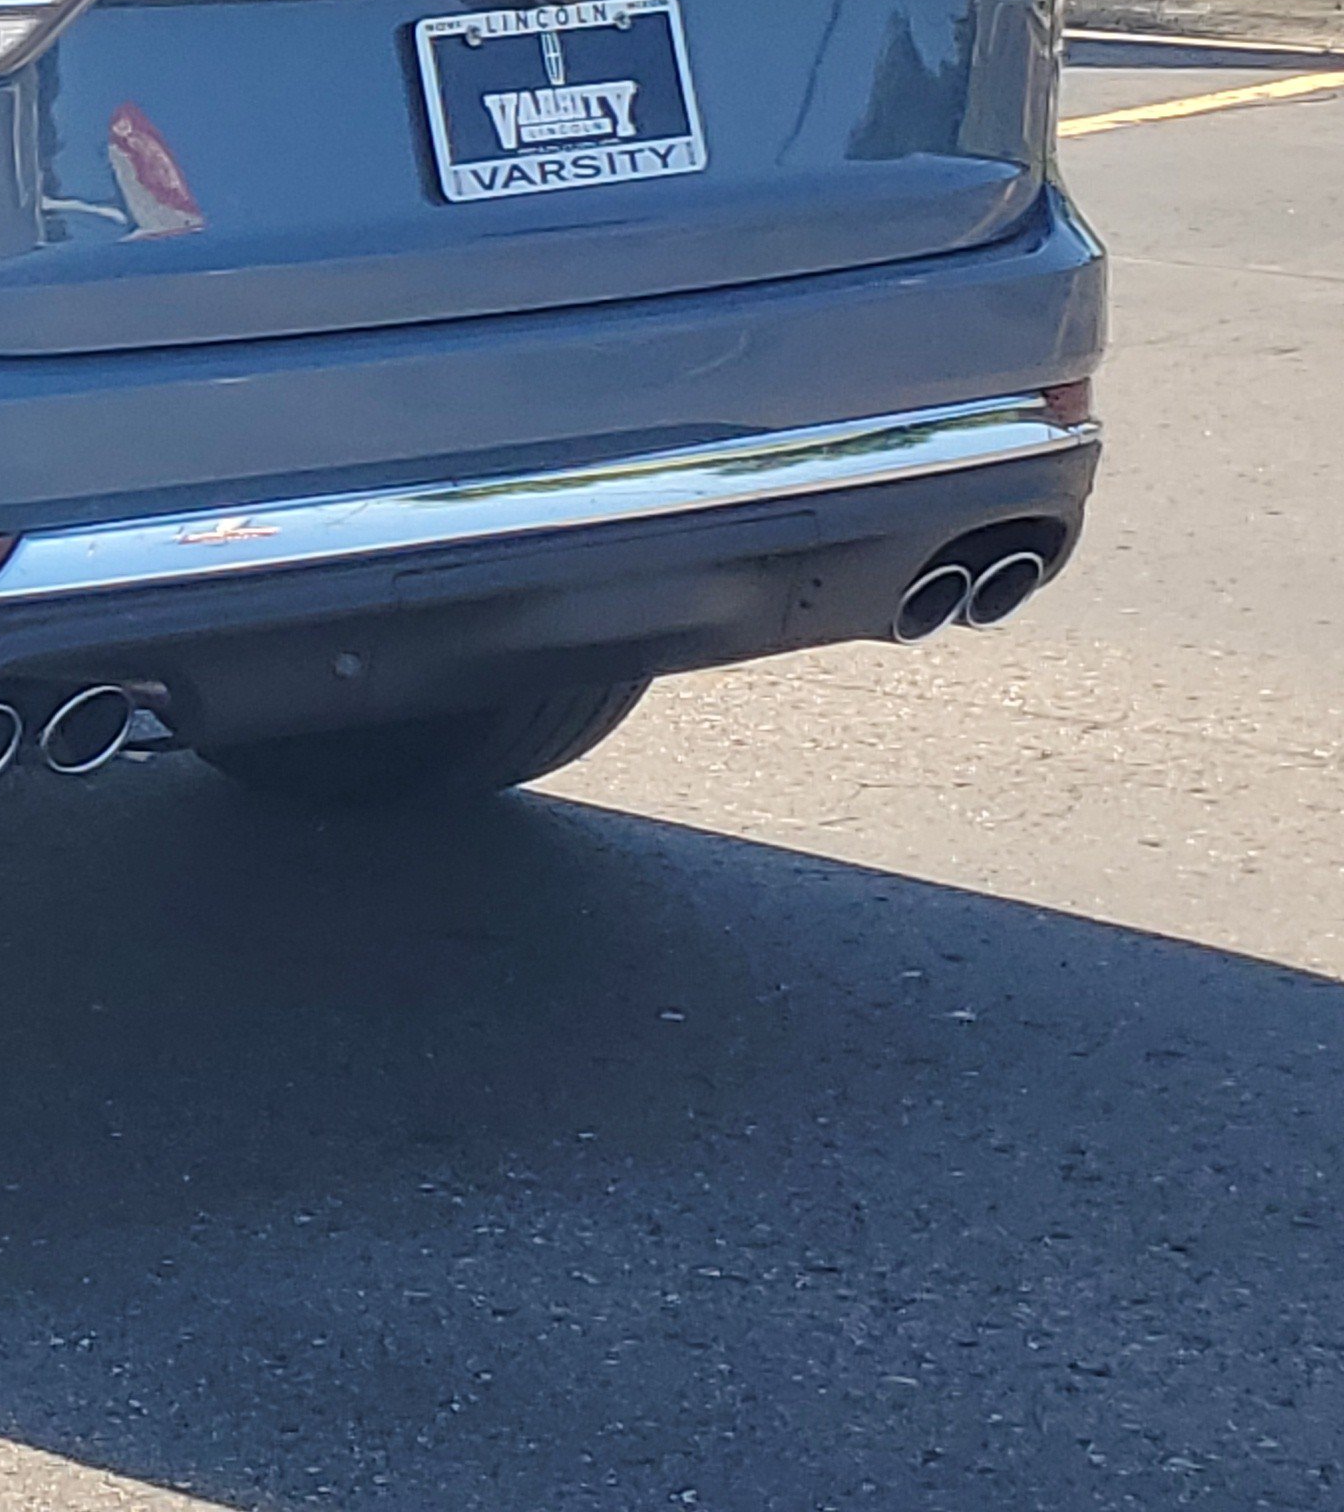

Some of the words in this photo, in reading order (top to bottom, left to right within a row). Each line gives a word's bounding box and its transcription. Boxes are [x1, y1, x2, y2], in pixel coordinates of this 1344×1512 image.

[484, 2, 608, 34] LINCOLN
[483, 80, 637, 150] VARSITY
[470, 144, 676, 191] VARSITY
